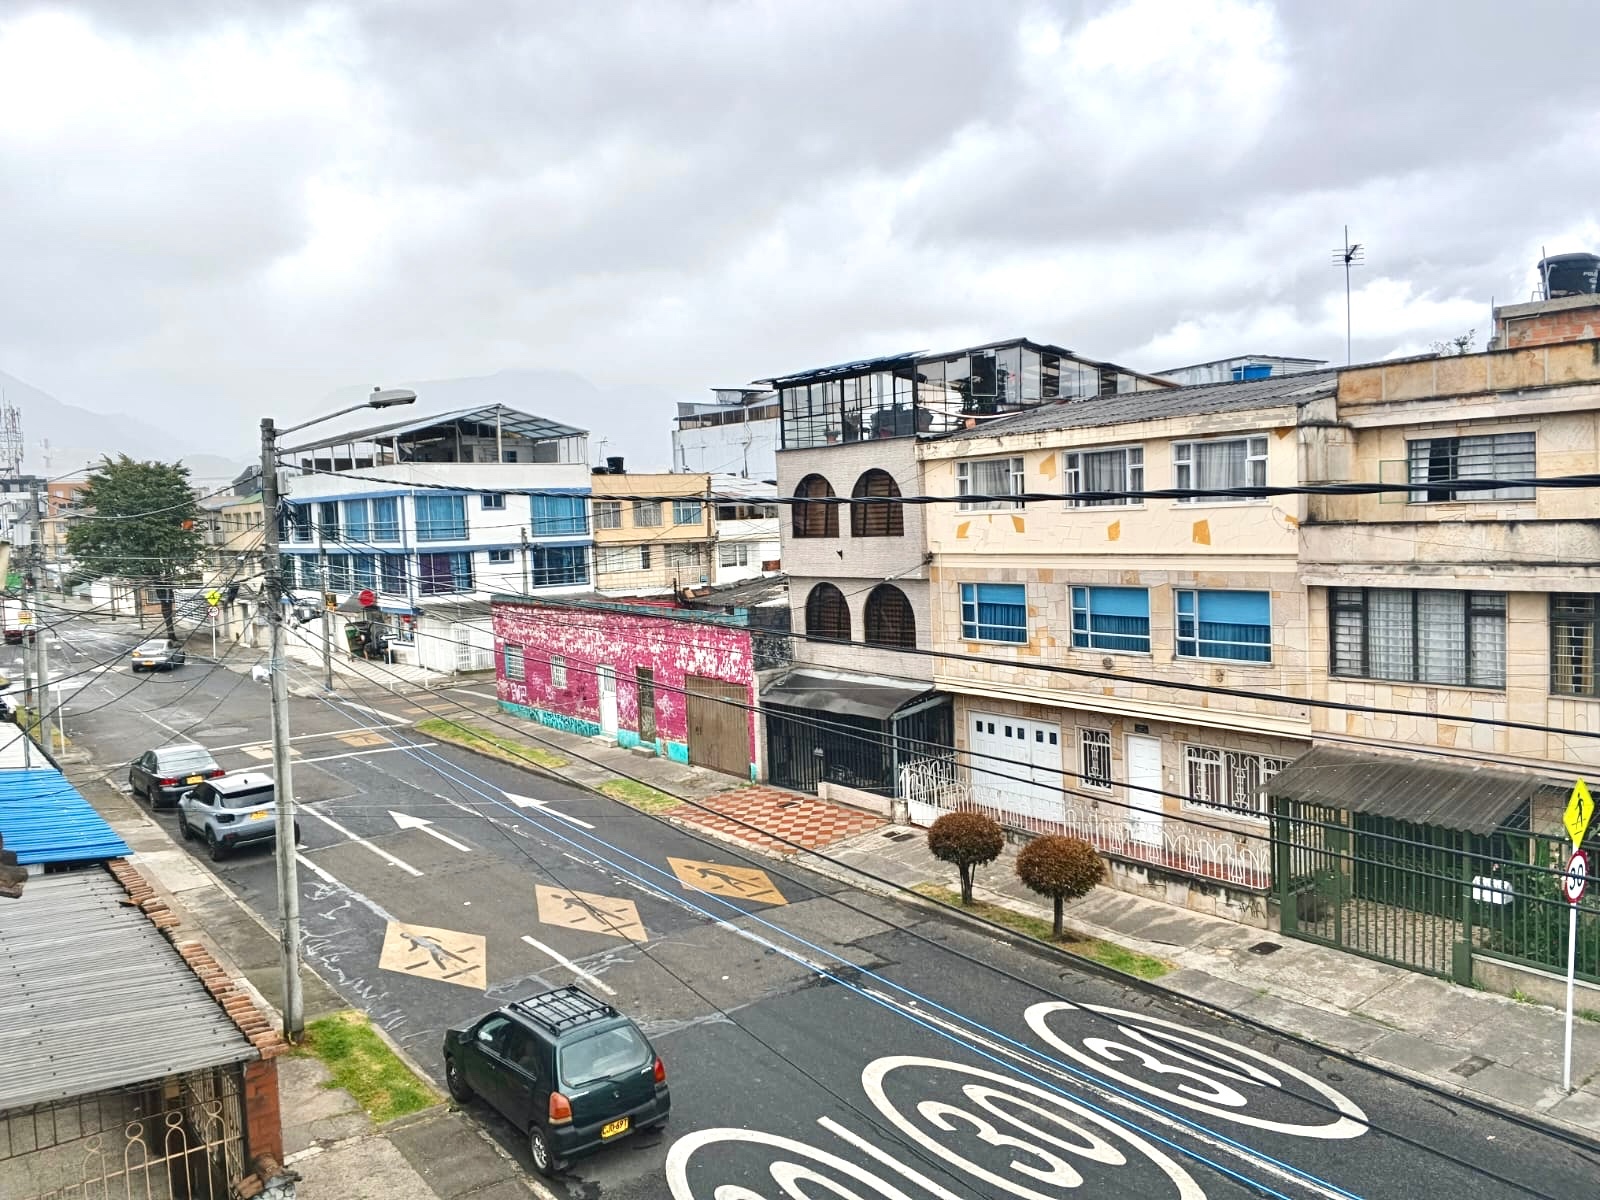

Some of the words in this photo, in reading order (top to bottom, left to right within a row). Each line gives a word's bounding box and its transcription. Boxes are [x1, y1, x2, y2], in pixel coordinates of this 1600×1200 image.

[1569, 863, 1583, 890] 30
[1083, 1025, 1281, 1106] 30
[917, 1084, 1127, 1188] 30
